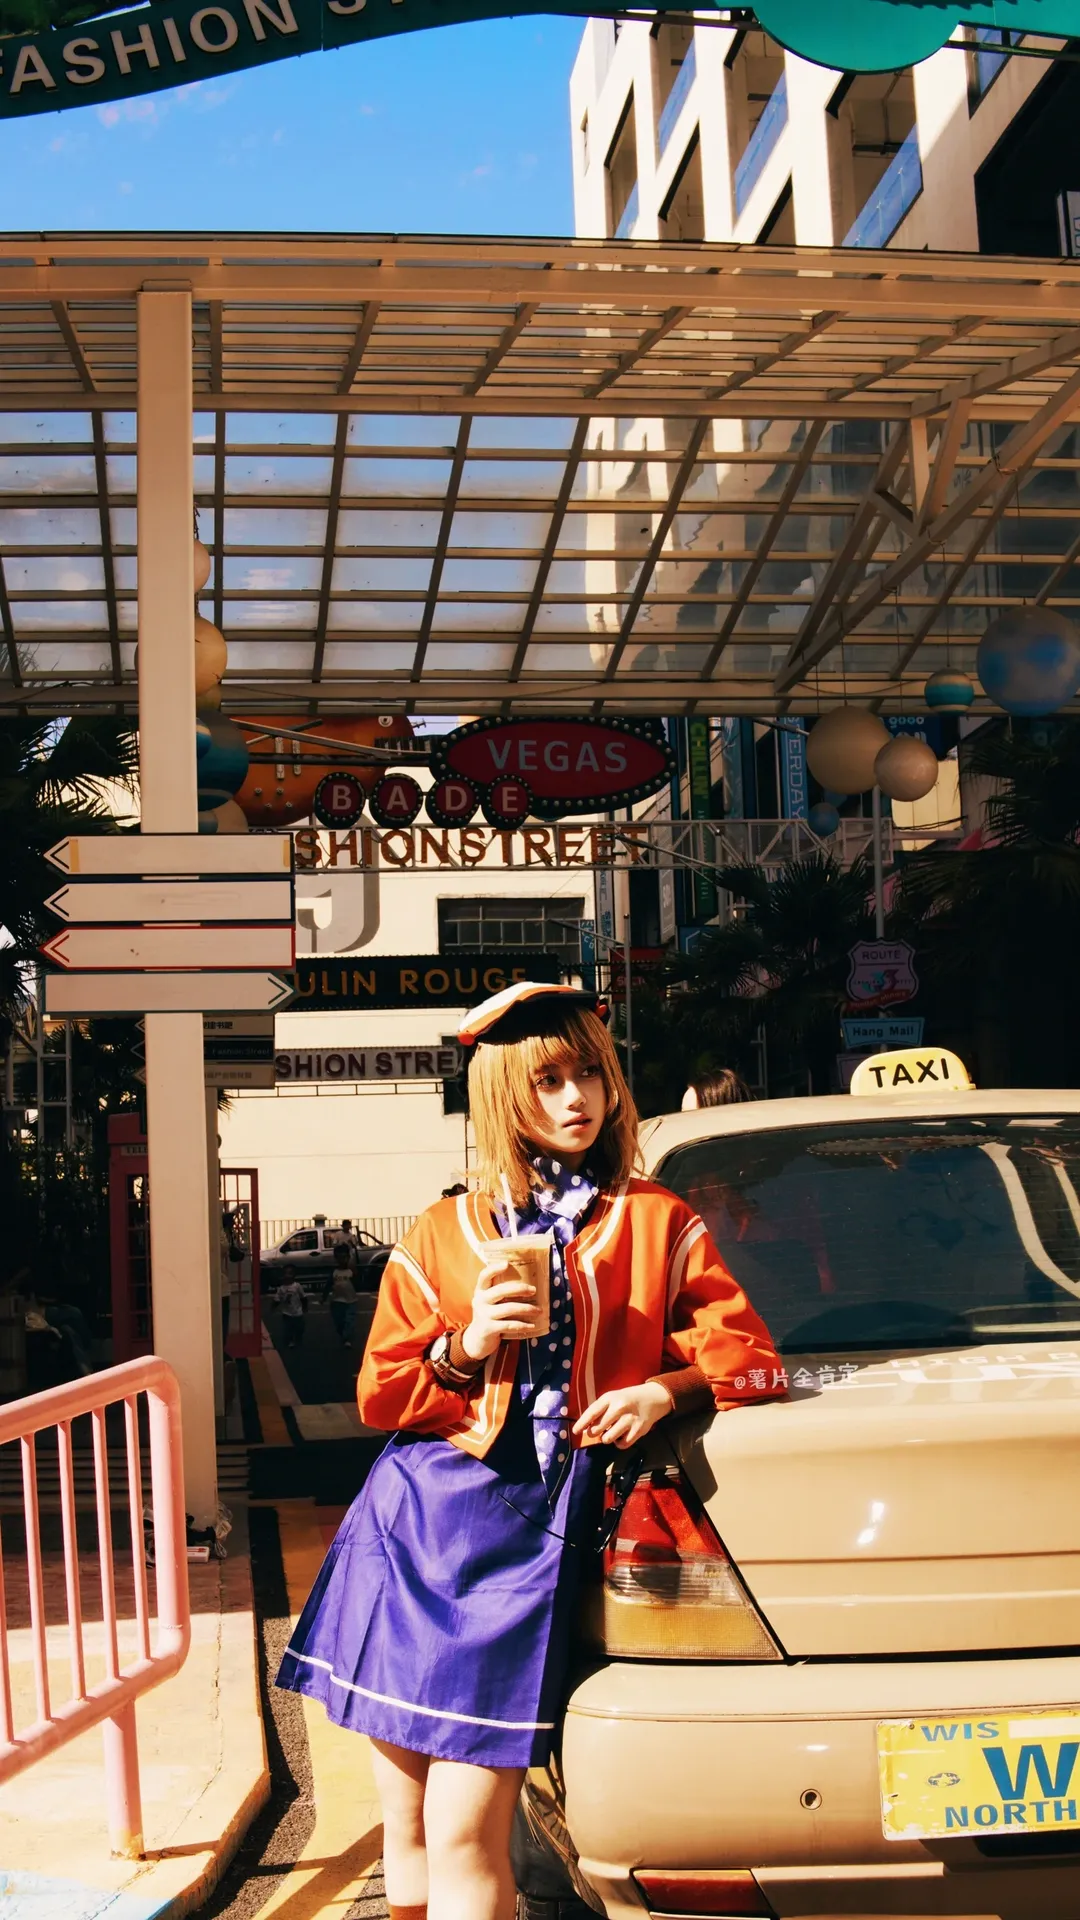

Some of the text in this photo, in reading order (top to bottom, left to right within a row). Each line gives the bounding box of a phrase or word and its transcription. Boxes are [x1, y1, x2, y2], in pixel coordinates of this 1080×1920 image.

[0, 0, 299, 94] ASHION
[486, 738, 629, 774] VEGAS
[861, 949, 900, 960] ROUTE
[852, 1027, 884, 1039] Hang
[868, 1057, 951, 1090] TAXI
[889, 1354, 1027, 1368] HIGH
[920, 1721, 1000, 1742] WIS
[981, 1741, 1080, 1801] W
[944, 1799, 1077, 1828] NORTH
